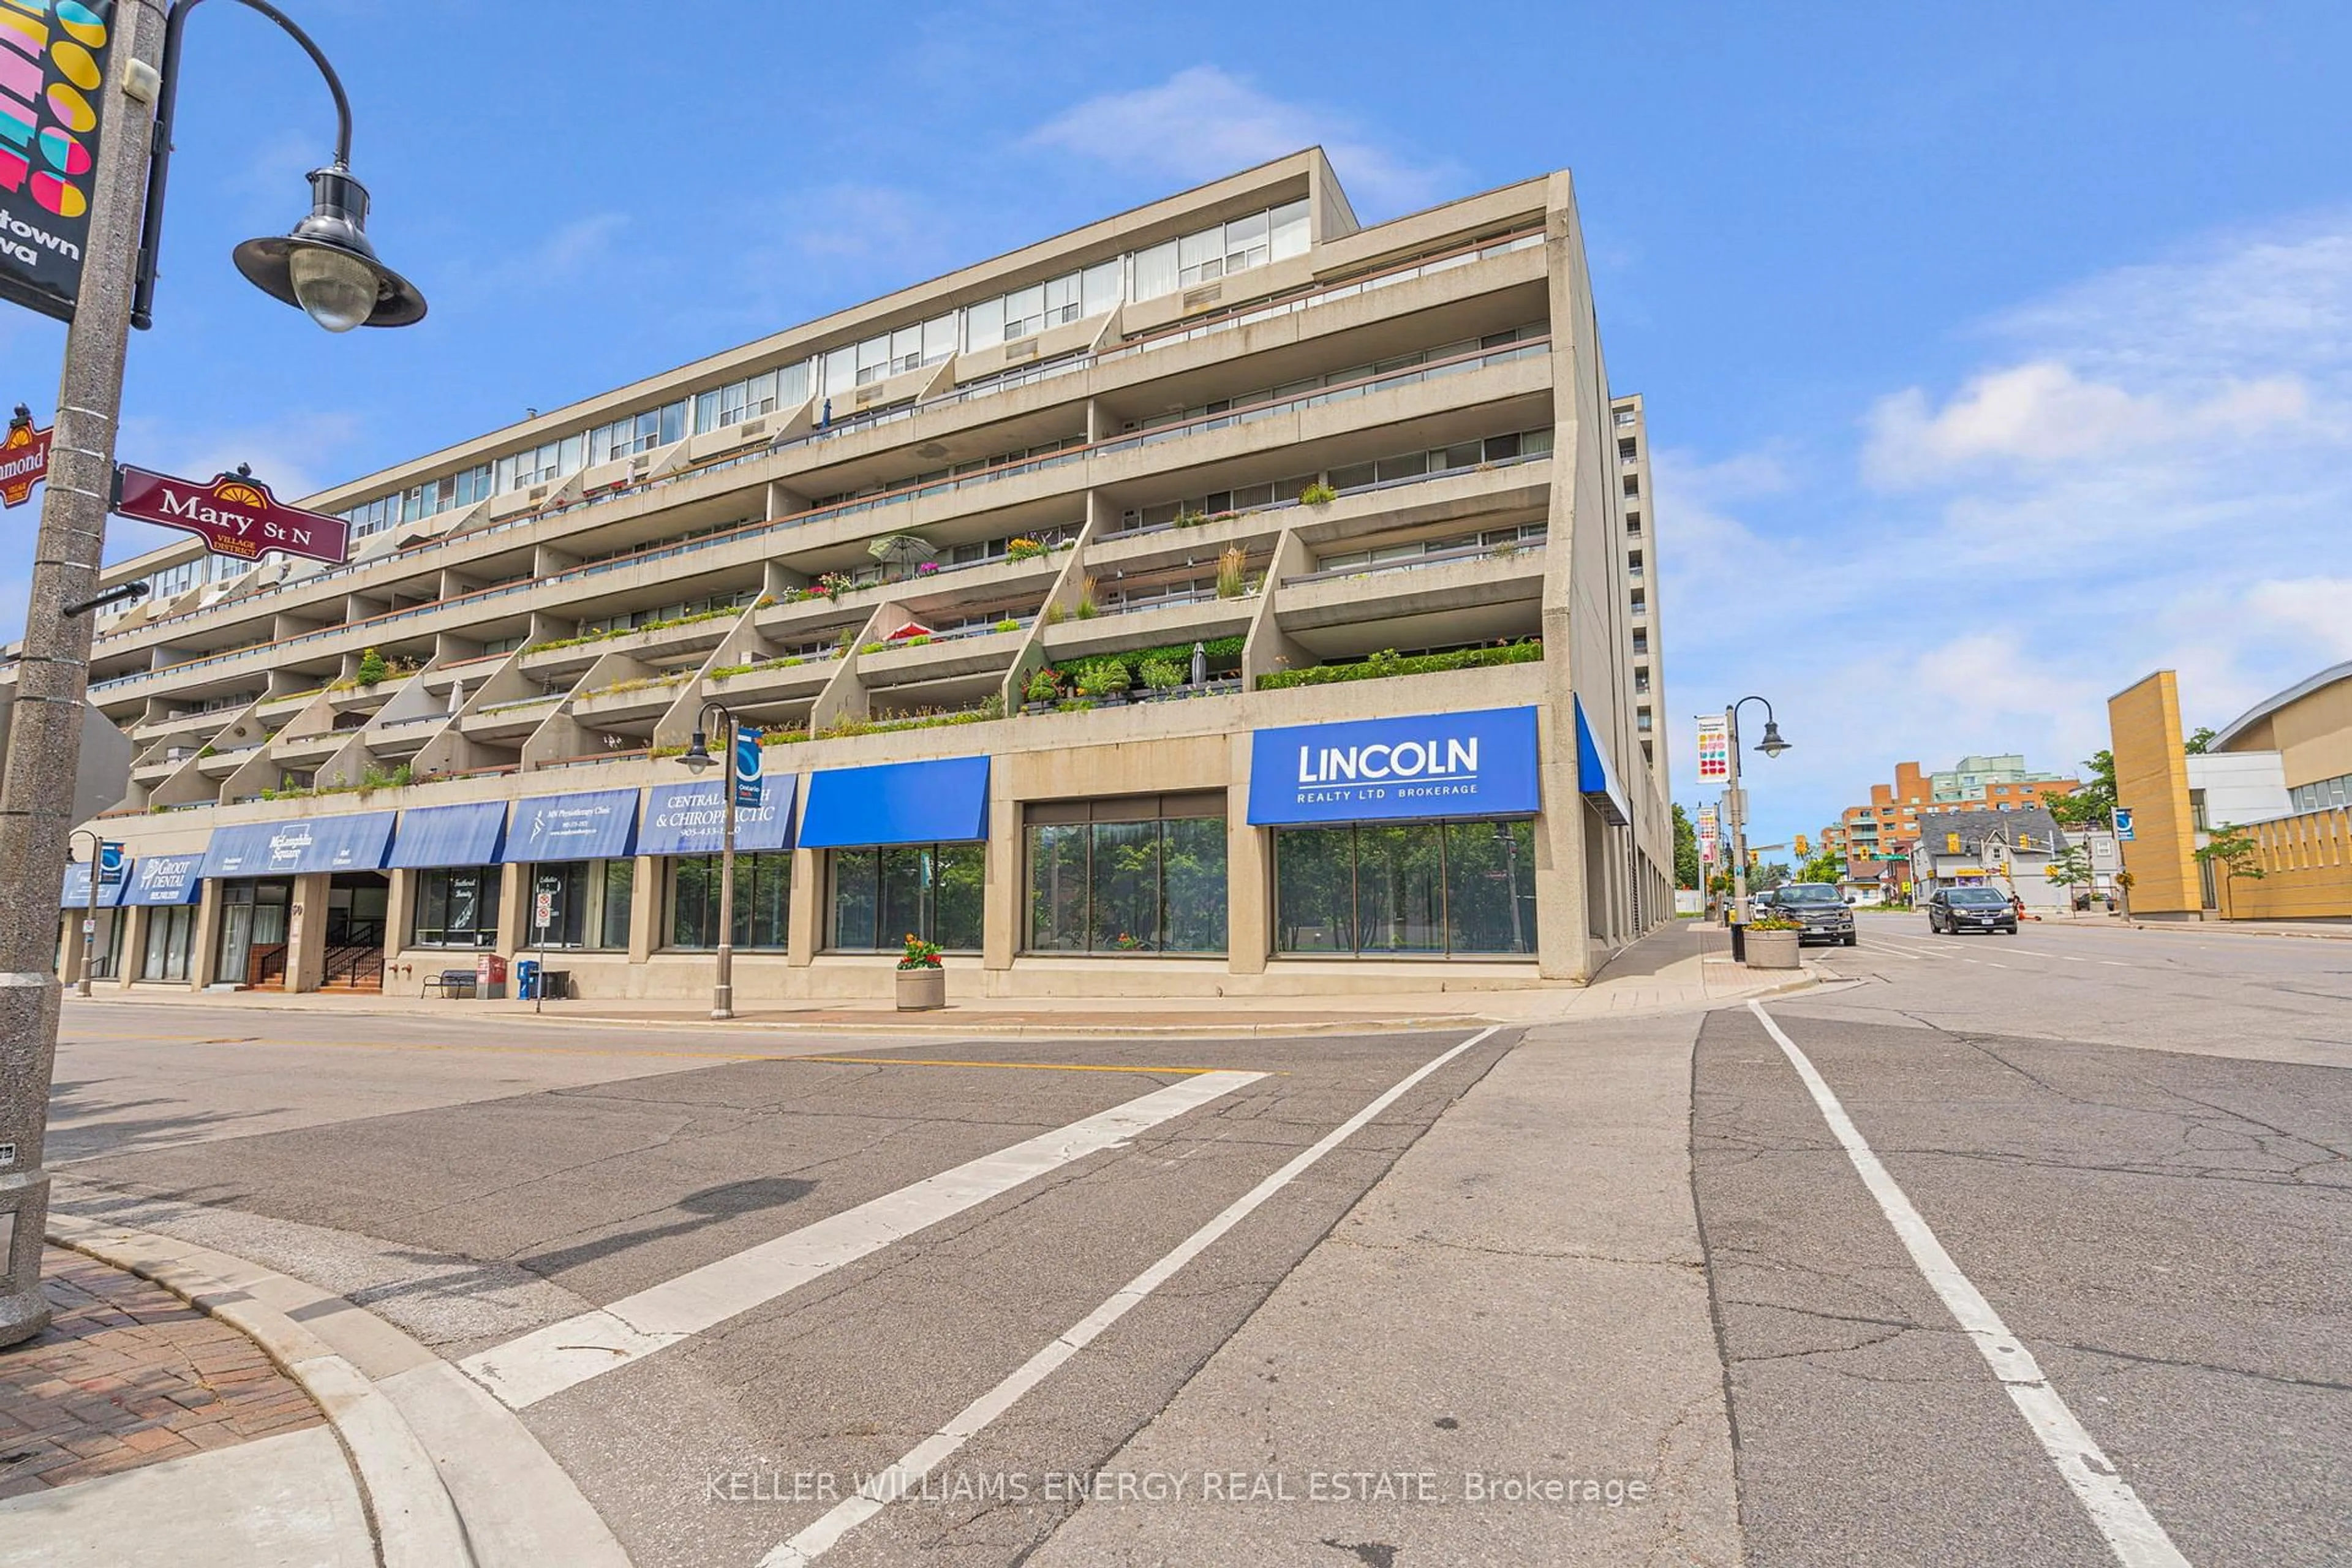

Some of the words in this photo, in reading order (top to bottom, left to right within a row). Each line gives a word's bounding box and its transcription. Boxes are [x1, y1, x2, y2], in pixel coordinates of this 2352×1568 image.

[159, 488, 254, 535] Mary
[264, 522, 287, 540] St
[292, 527, 311, 545] N
[214, 541, 256, 556] DISTRICT
[217, 534, 256, 549] VILLAGE
[1298, 737, 1478, 783] LINCOLN
[668, 793, 720, 809] CENTRAL
[1297, 791, 1351, 804] REALTY
[1359, 788, 1385, 800] LTD
[1399, 784, 1477, 797] BROKERAGE
[656, 815, 667, 827] &
[152, 875, 185, 888] DENTAL
